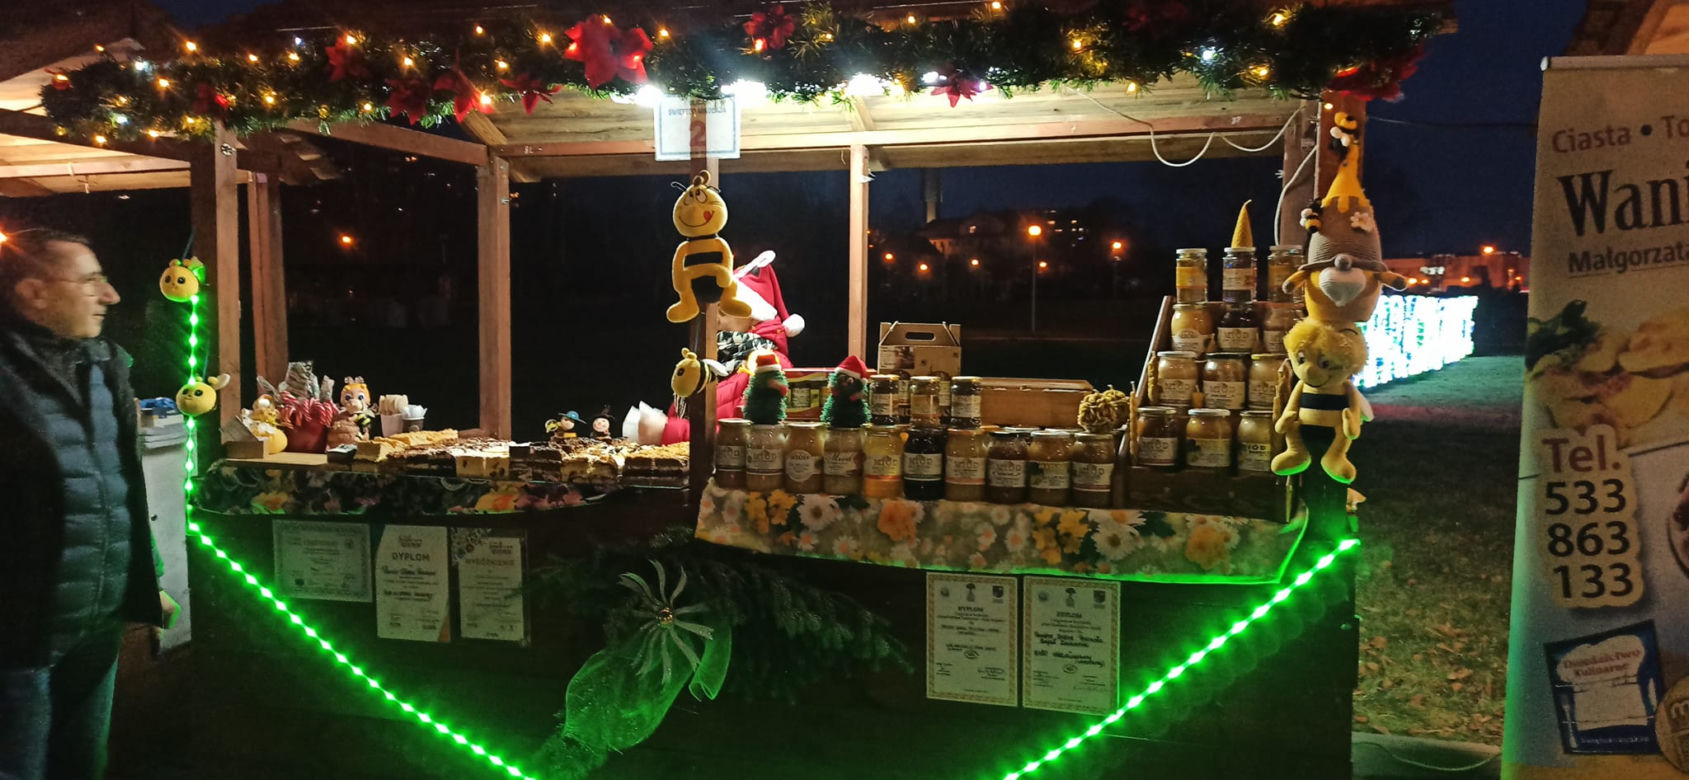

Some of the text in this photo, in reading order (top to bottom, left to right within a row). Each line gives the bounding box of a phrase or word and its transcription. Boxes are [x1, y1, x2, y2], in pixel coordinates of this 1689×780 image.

[690, 120, 706, 147] 2
[1552, 125, 1631, 153] Ciasta
[1568, 241, 1689, 274] Małgorzat
[1542, 435, 1621, 473] Tel.
[1545, 478, 1627, 516] 533
[1548, 520, 1631, 557] 863
[391, 551, 430, 562] DYPLOM
[1553, 563, 1633, 599] 133
